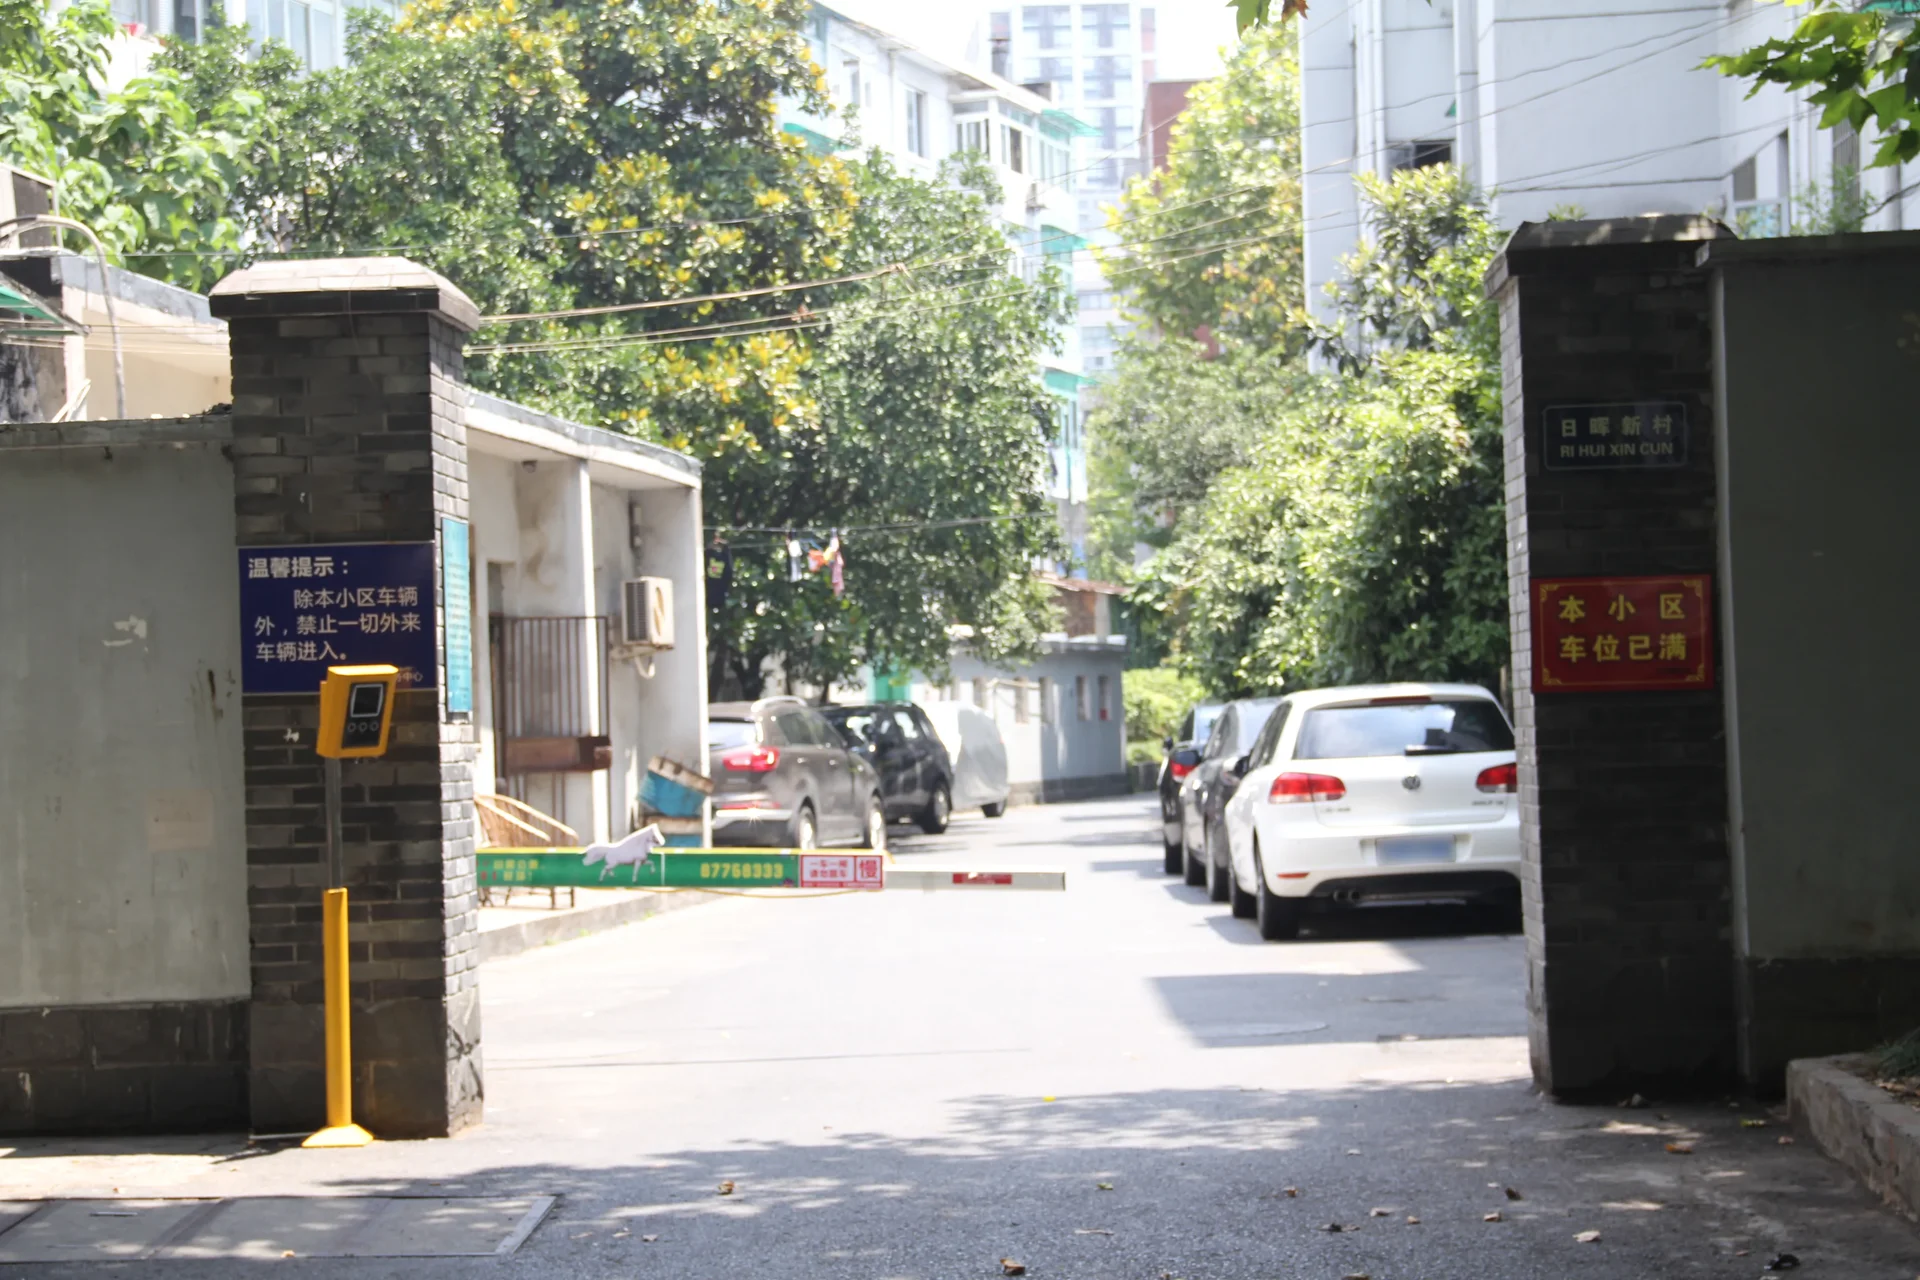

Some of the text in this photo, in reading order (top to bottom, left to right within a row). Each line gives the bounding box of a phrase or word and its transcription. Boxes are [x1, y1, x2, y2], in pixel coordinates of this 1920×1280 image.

[1560, 441, 1673, 458] RI HUI XIN CUN
[293, 586, 419, 609] 除本小区车辆
[1558, 593, 1686, 623] 本小区
[254, 612, 421, 637] 外，禁止一切外来
[256, 640, 347, 663] 车辆进入。
[1559, 632, 1687, 663] 车位已满
